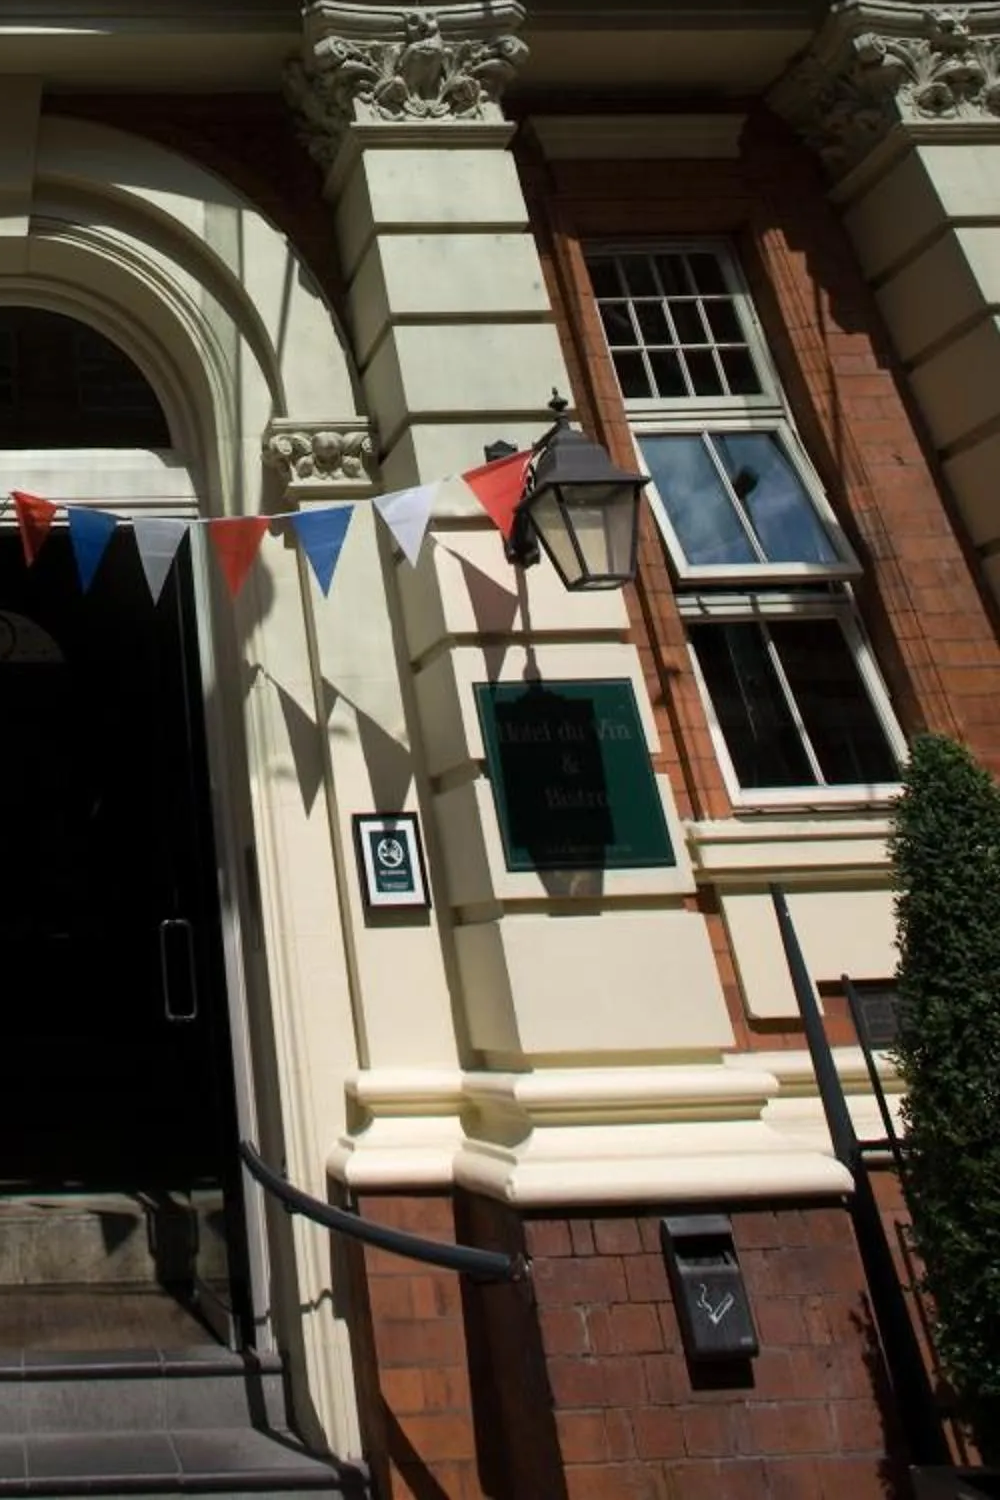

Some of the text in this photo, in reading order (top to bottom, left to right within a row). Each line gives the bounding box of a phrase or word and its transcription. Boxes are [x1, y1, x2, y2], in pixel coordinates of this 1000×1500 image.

[497, 719, 632, 742] Hotel du Vin
[559, 752, 581, 774] &
